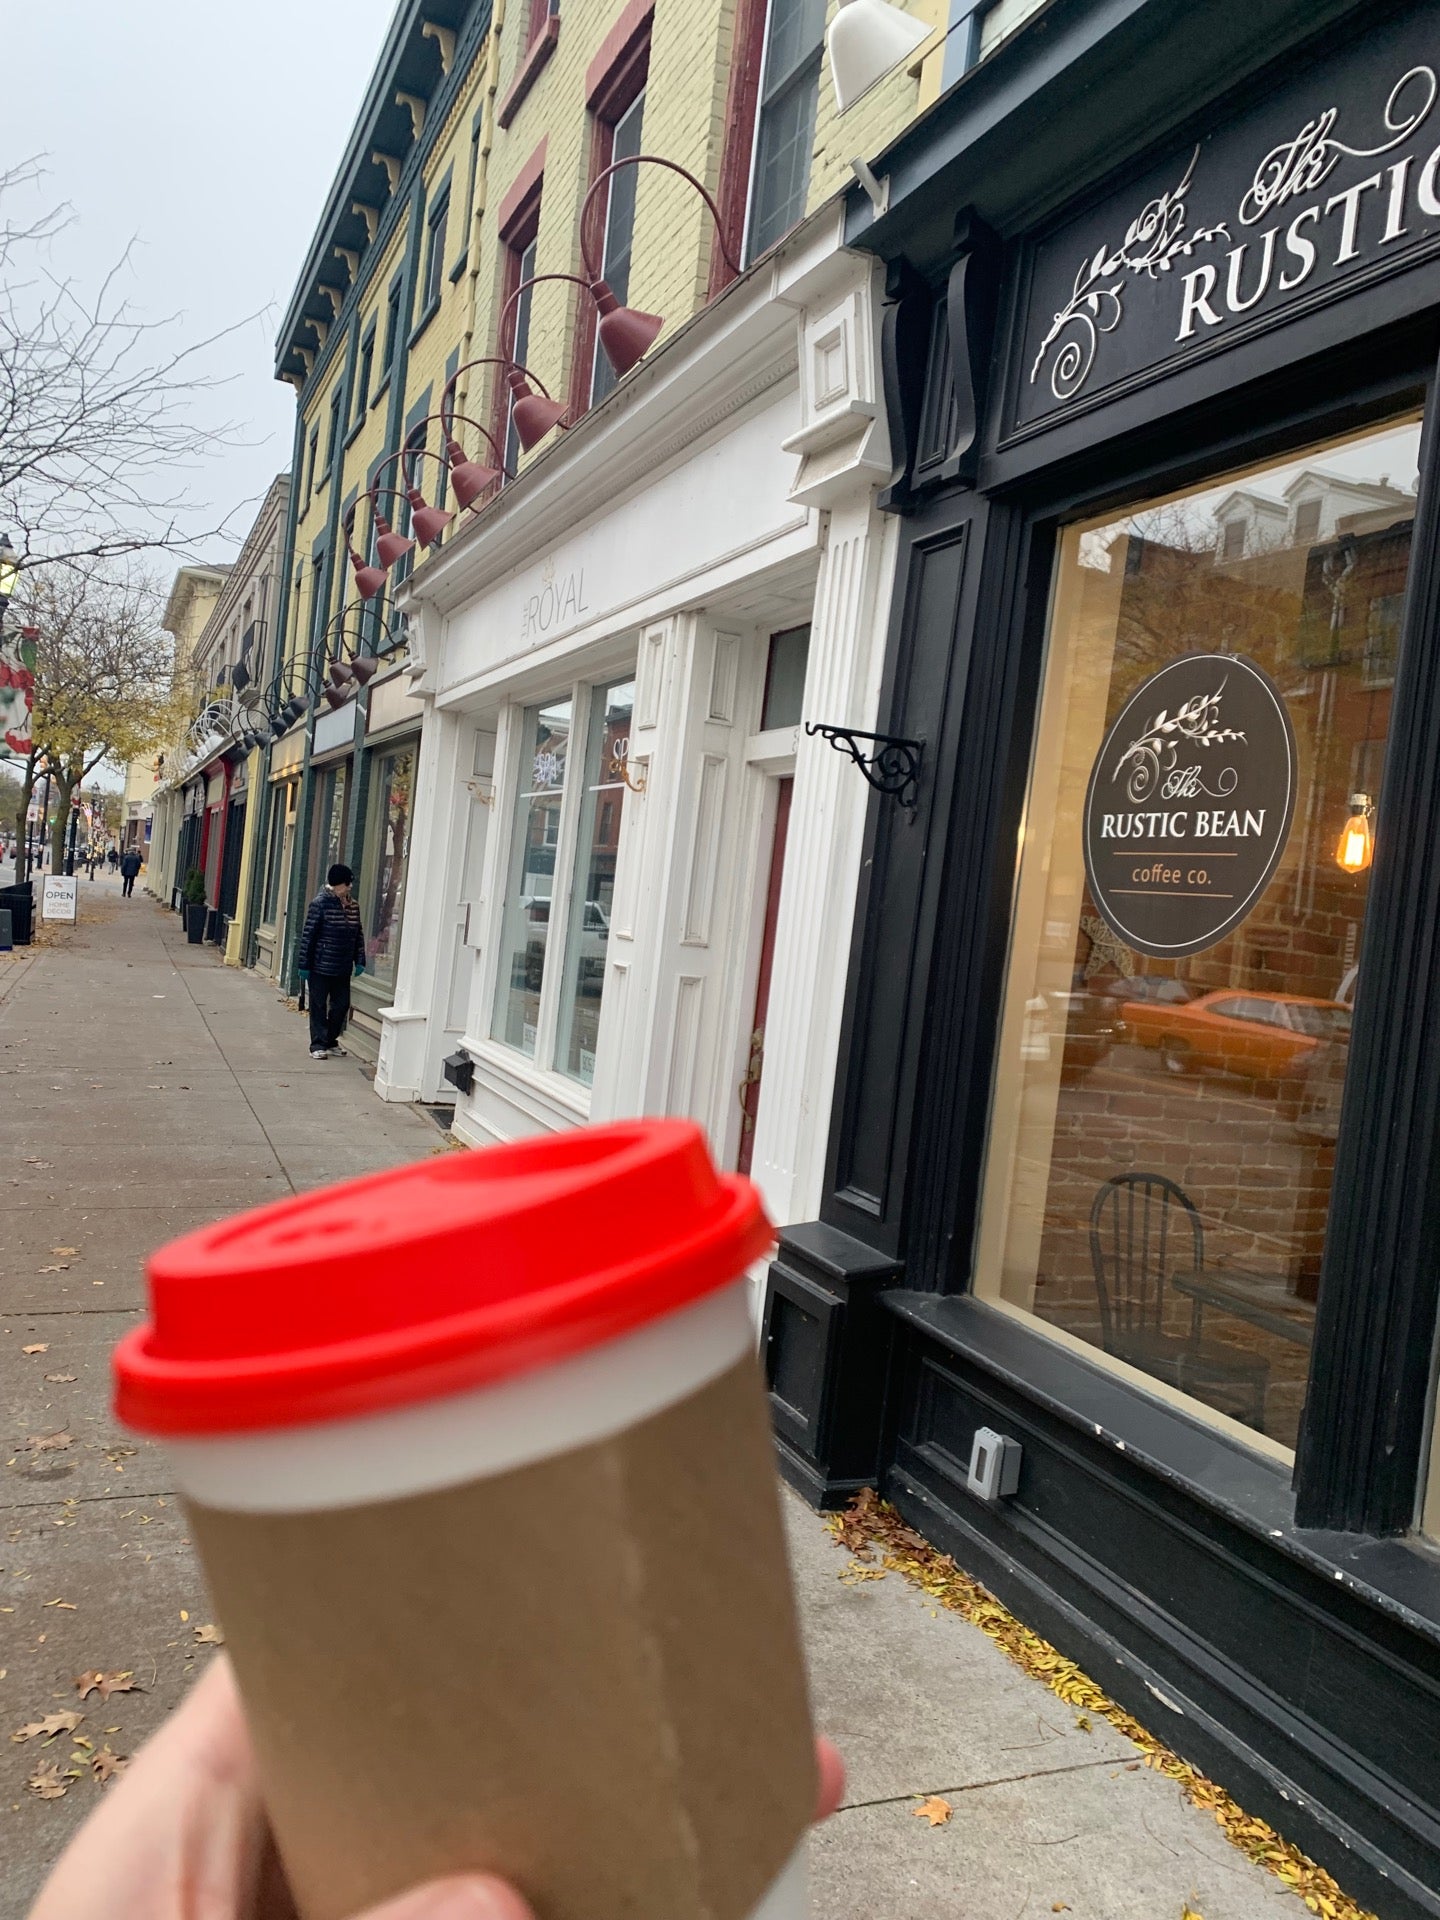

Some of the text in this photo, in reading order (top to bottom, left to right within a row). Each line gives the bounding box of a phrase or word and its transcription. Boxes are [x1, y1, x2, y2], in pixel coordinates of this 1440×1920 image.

[526, 567, 589, 638] ROYAL
[1100, 809, 1267, 839] RUSTIC BEAN
[1132, 863, 1212, 884] coffee co.
[45, 891, 74, 900] OPEN
